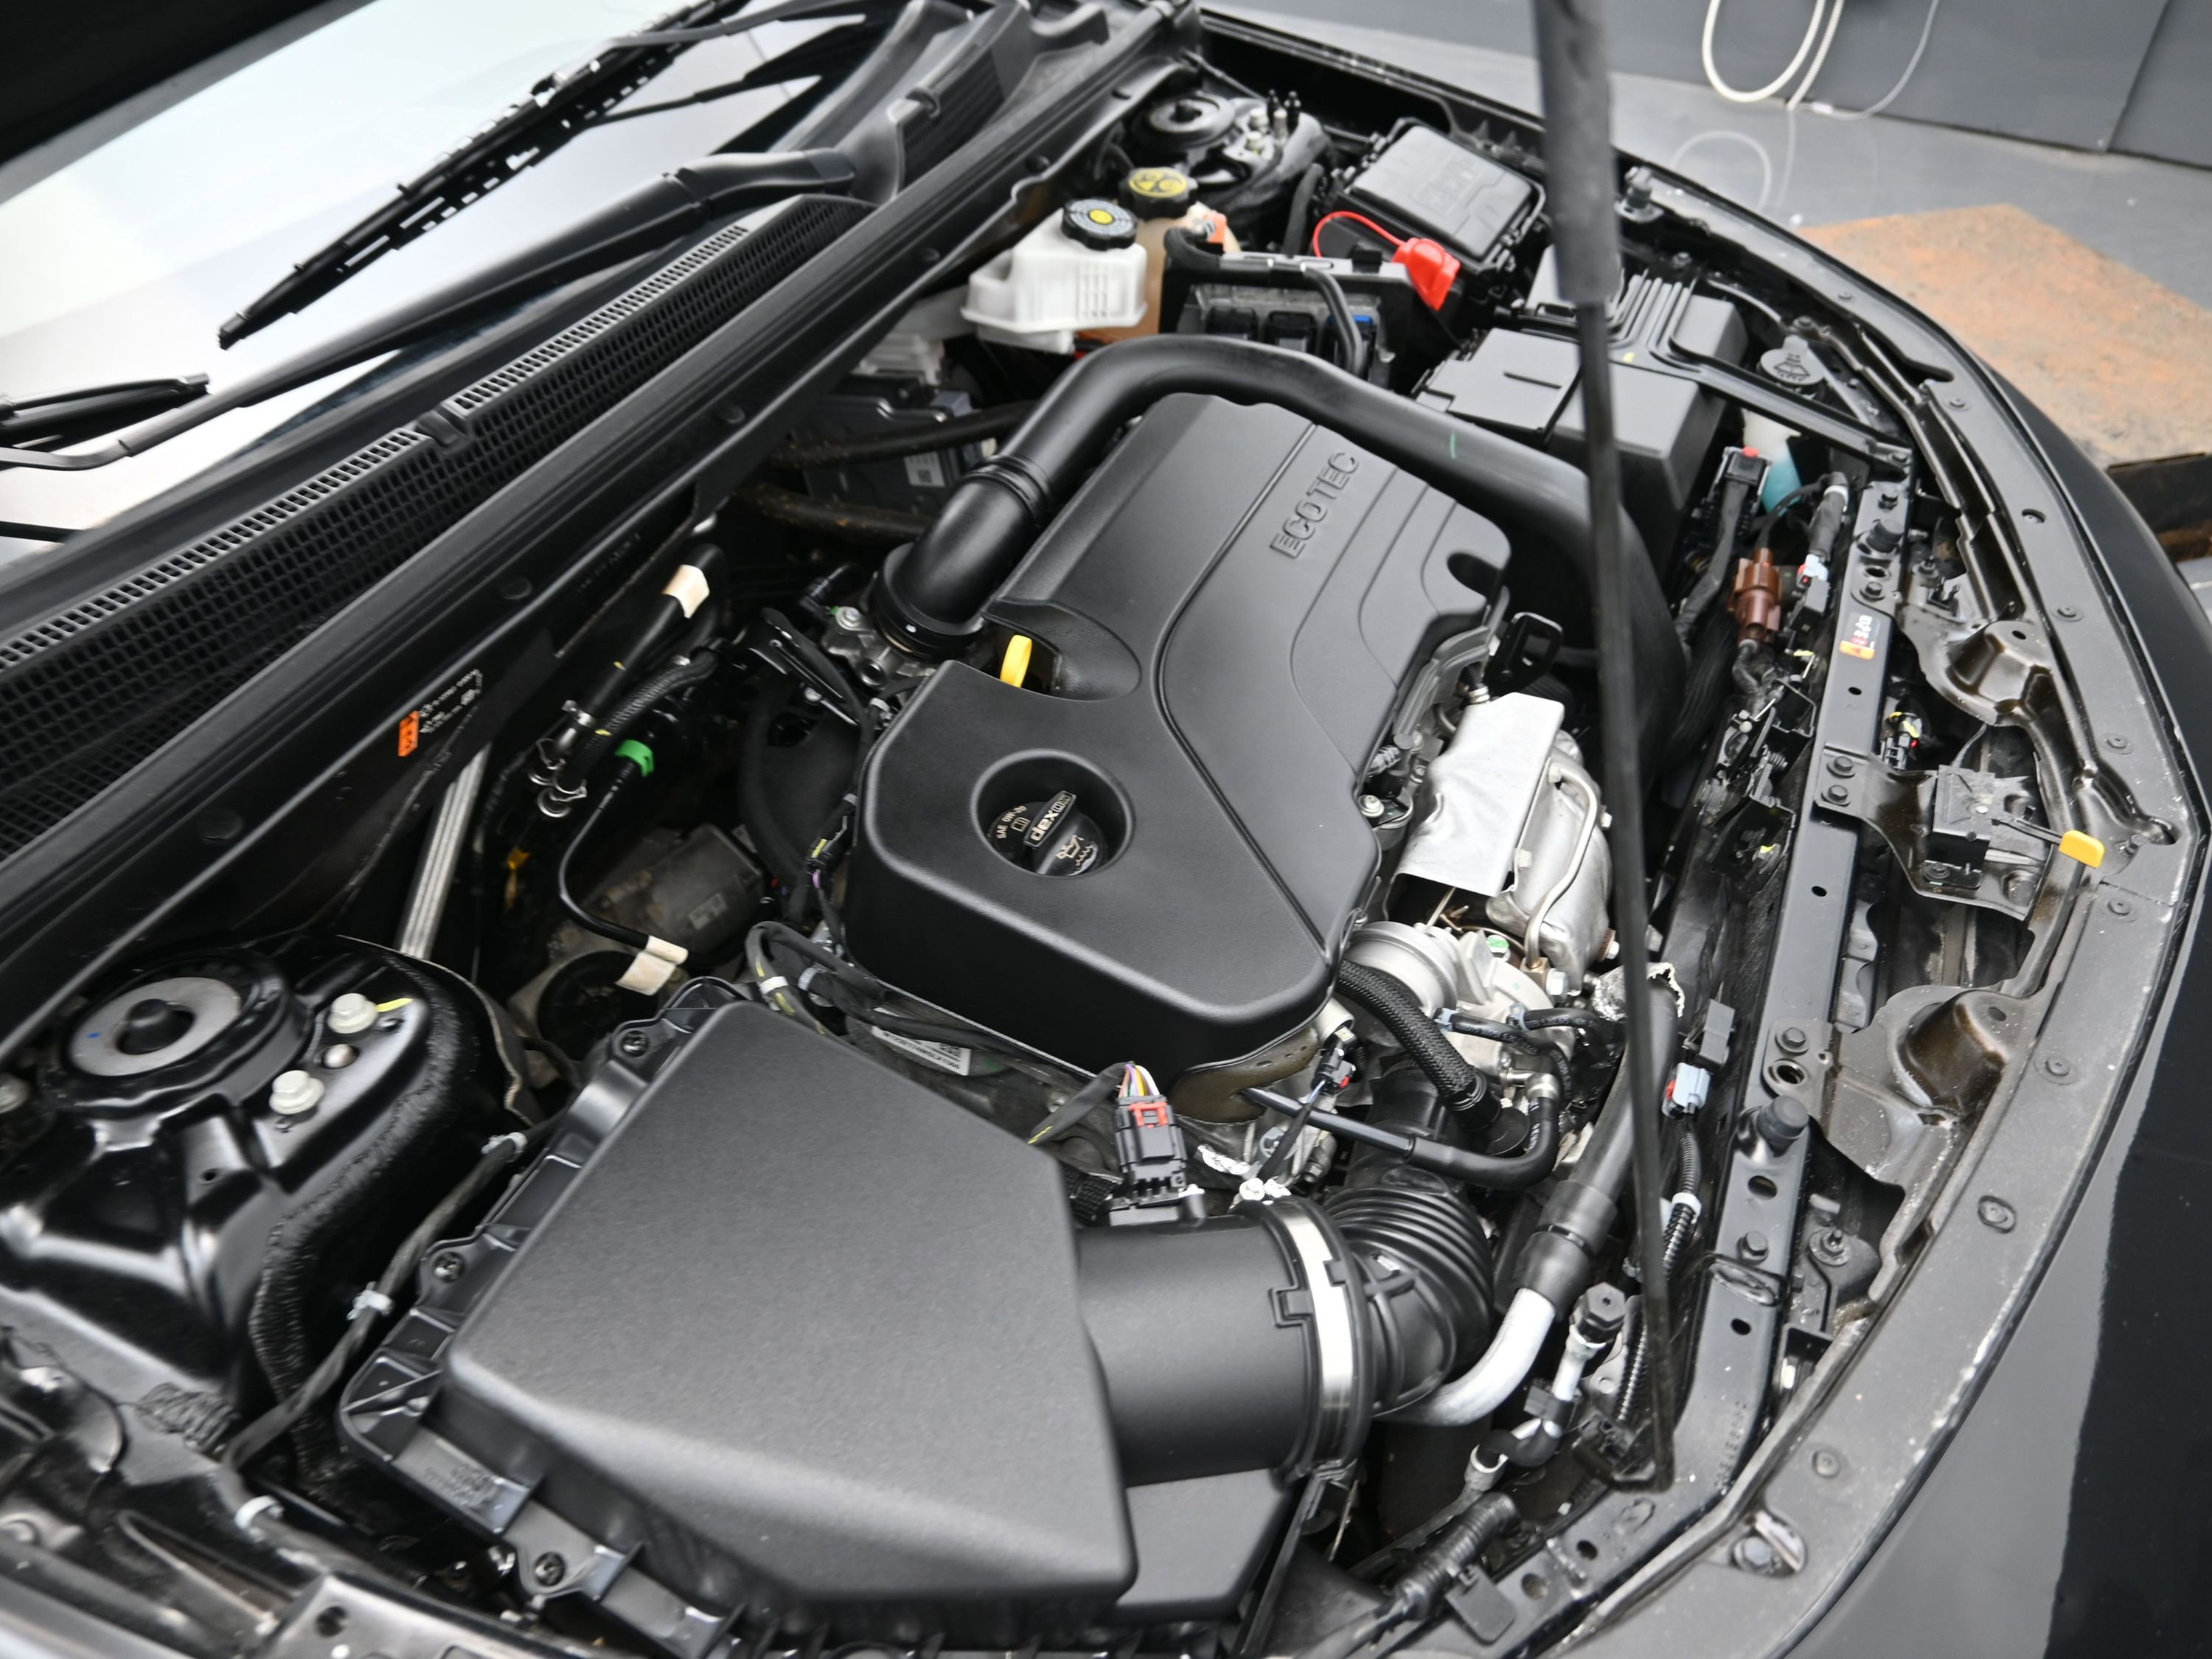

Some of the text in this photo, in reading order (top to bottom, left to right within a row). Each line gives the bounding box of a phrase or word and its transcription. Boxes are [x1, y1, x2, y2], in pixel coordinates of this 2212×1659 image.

[1269, 452, 1359, 559] ECOTEC
[996, 824, 1008, 839] SAE
[1030, 794, 1071, 841] dexos
